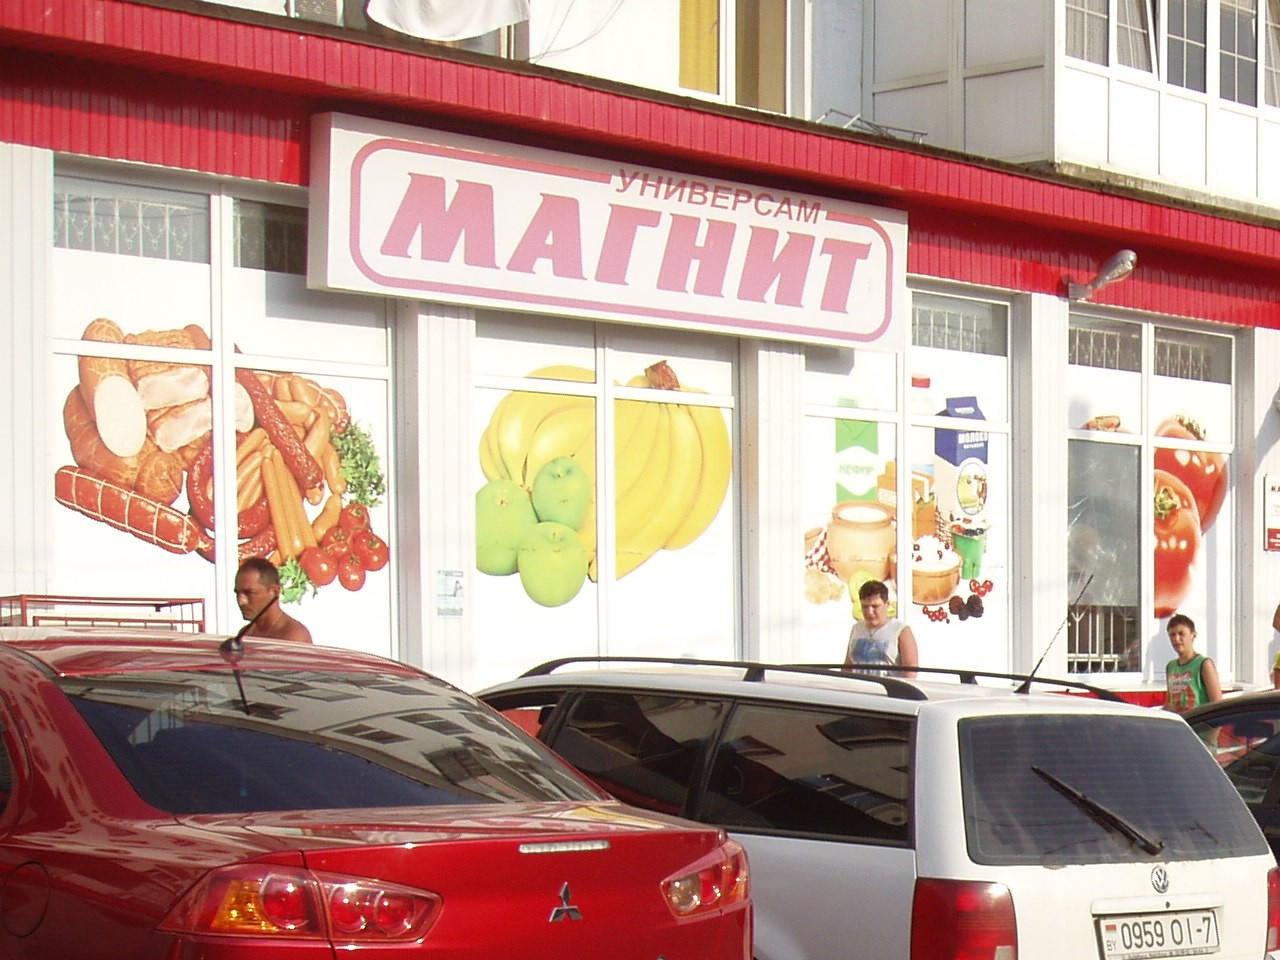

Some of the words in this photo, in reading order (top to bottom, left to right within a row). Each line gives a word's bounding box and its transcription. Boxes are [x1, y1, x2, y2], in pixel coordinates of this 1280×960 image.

[615, 168, 823, 225] УНИВЕРСАМ
[379, 172, 873, 315] МАГНИТ
[1106, 940, 1116, 951] BY
[1121, 920, 1165, 949] 0959
